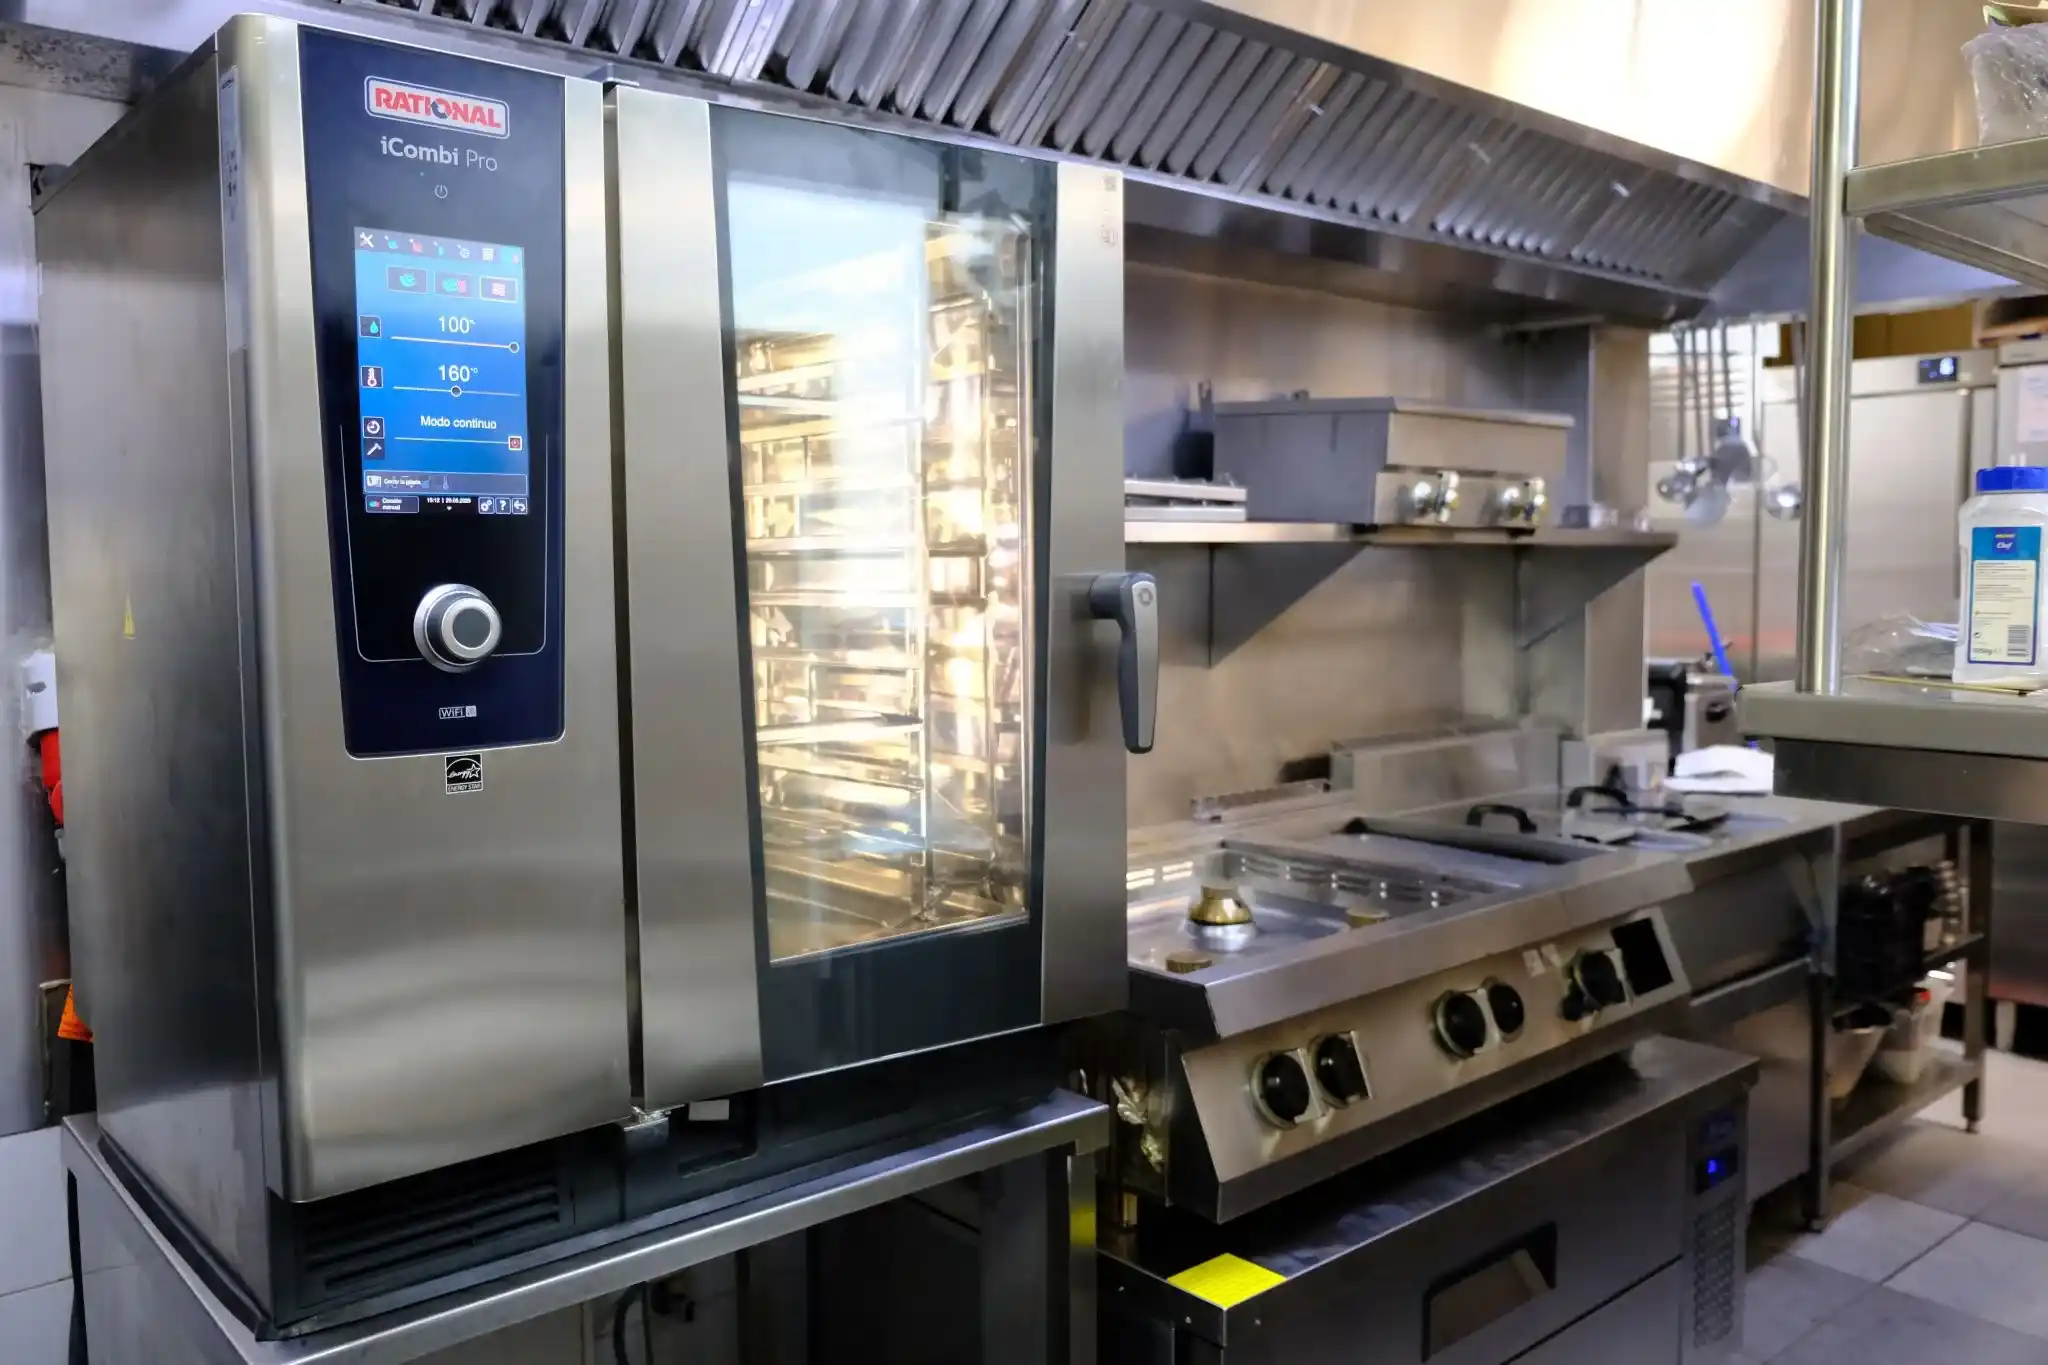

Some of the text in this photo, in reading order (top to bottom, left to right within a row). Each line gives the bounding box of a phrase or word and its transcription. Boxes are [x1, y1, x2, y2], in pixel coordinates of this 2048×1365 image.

[375, 87, 501, 128] RATIONAL
[380, 136, 498, 171] iCombi Pro
[420, 415, 497, 430] Modo continuo
